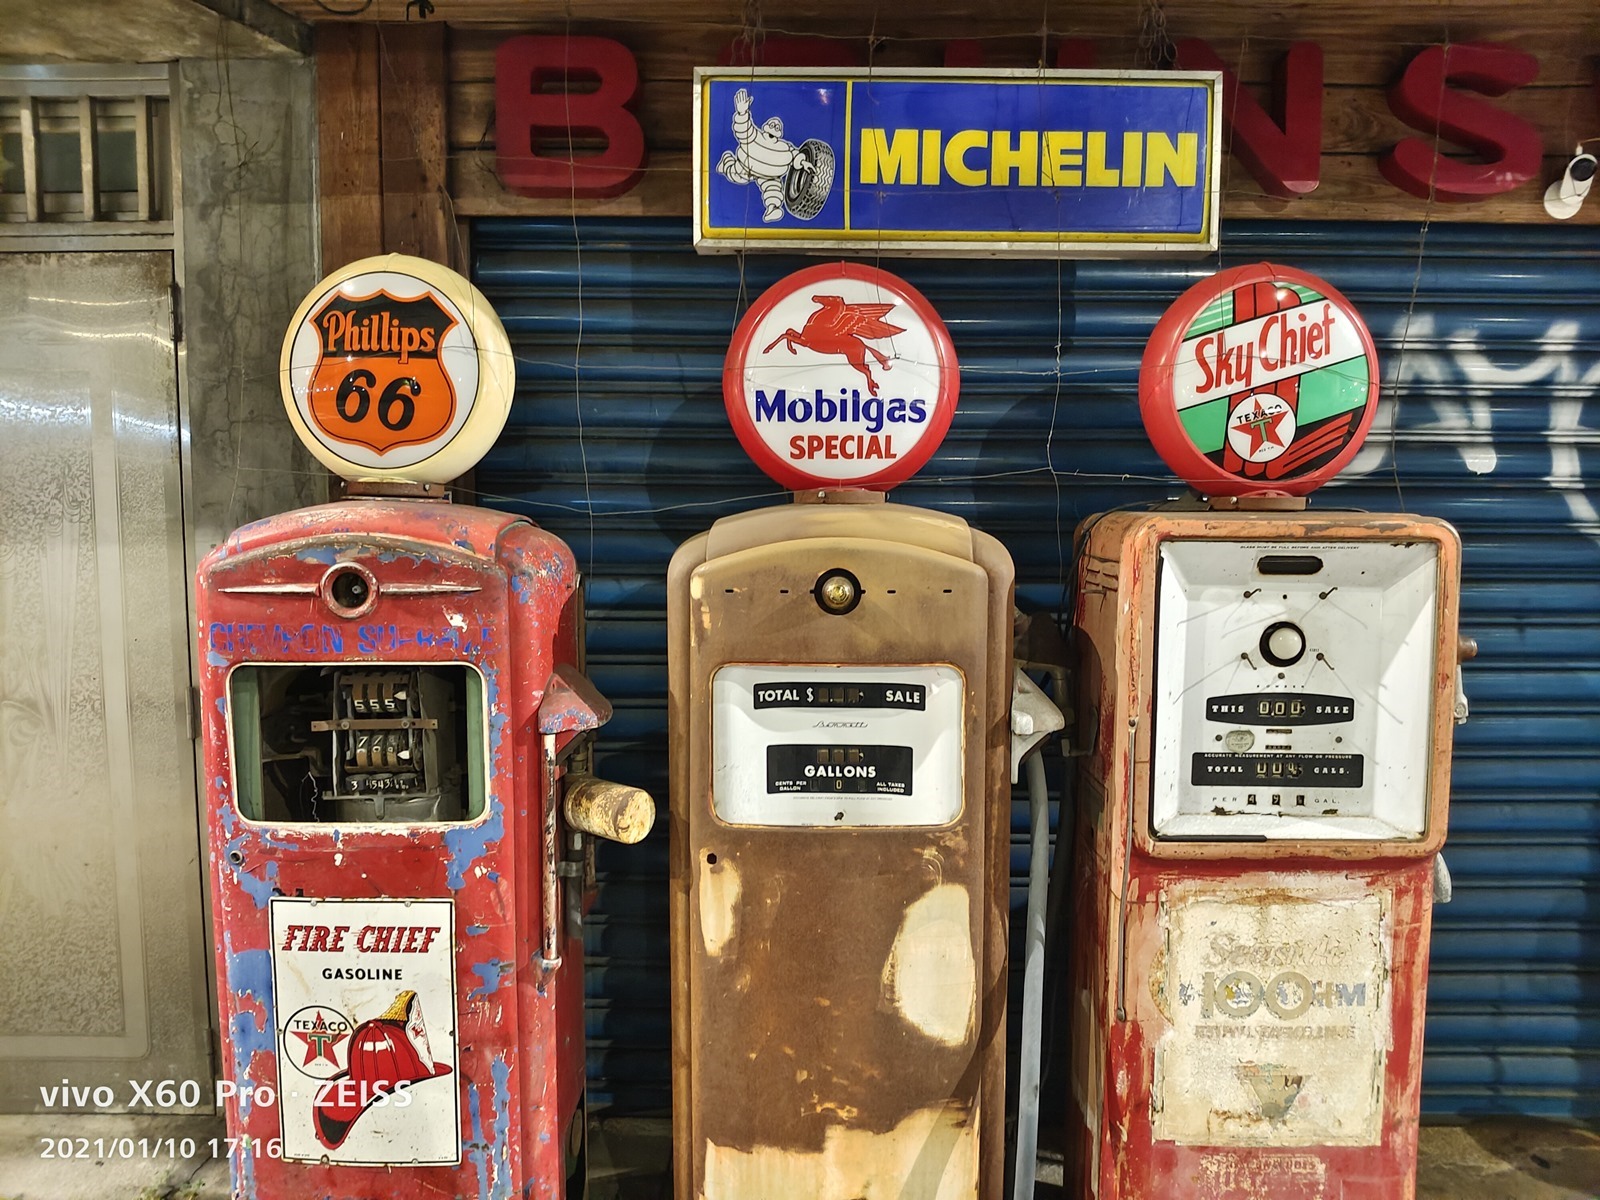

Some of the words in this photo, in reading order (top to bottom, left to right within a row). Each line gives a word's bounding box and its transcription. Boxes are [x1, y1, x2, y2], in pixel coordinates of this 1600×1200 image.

[860, 128, 1198, 188] MICHELIN
[322, 309, 437, 364] Phillips
[1194, 331, 1254, 394] Sky
[1258, 303, 1336, 372] Chief
[335, 368, 421, 431] 66
[755, 388, 927, 433] Mobilgas
[789, 435, 897, 460] SPECIAL
[757, 689, 800, 702] TOTAL
[806, 687, 814, 703] $
[885, 690, 921, 704] SALE
[1211, 705, 1245, 713] THIS
[1316, 706, 1349, 714] SALE
[804, 765, 877, 778] GALLONS
[281, 924, 350, 952] FIRE
[356, 925, 441, 953] CHIEF
[322, 968, 403, 980] GASOLINE
[294, 1019, 348, 1032] TEXACO
